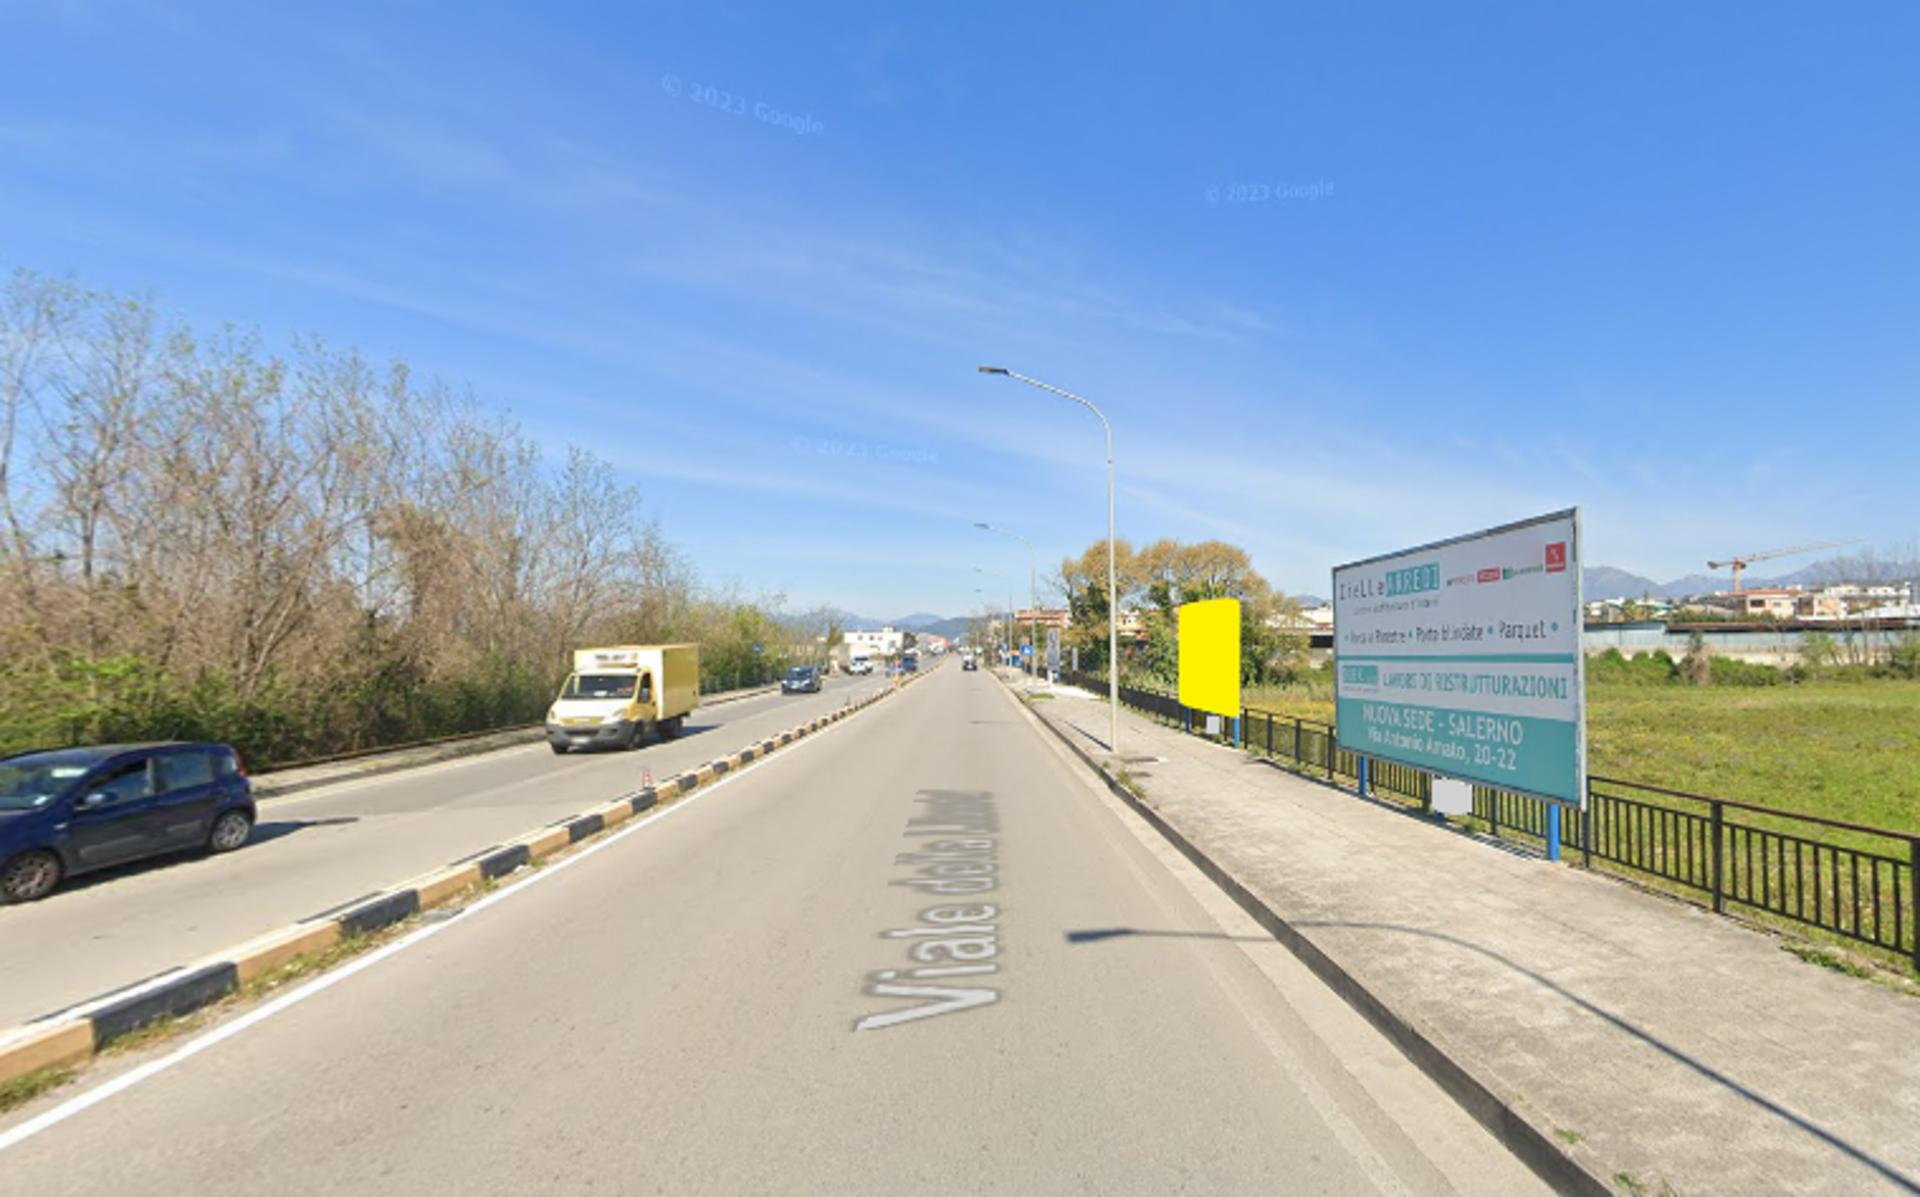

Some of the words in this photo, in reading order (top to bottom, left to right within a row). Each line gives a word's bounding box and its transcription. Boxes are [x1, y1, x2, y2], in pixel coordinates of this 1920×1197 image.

[1499, 619, 1546, 642] Parquet
[1420, 672, 1432, 692] DI
[1436, 673, 1568, 699] RISTRUTTURAZIONI
[1362, 703, 1401, 727] NUOVA
[1402, 708, 1434, 733] SEDE
[1448, 712, 1524, 746] SALERNO
[1366, 726, 1382, 743] Via
[1383, 730, 1423, 753] Antonio
